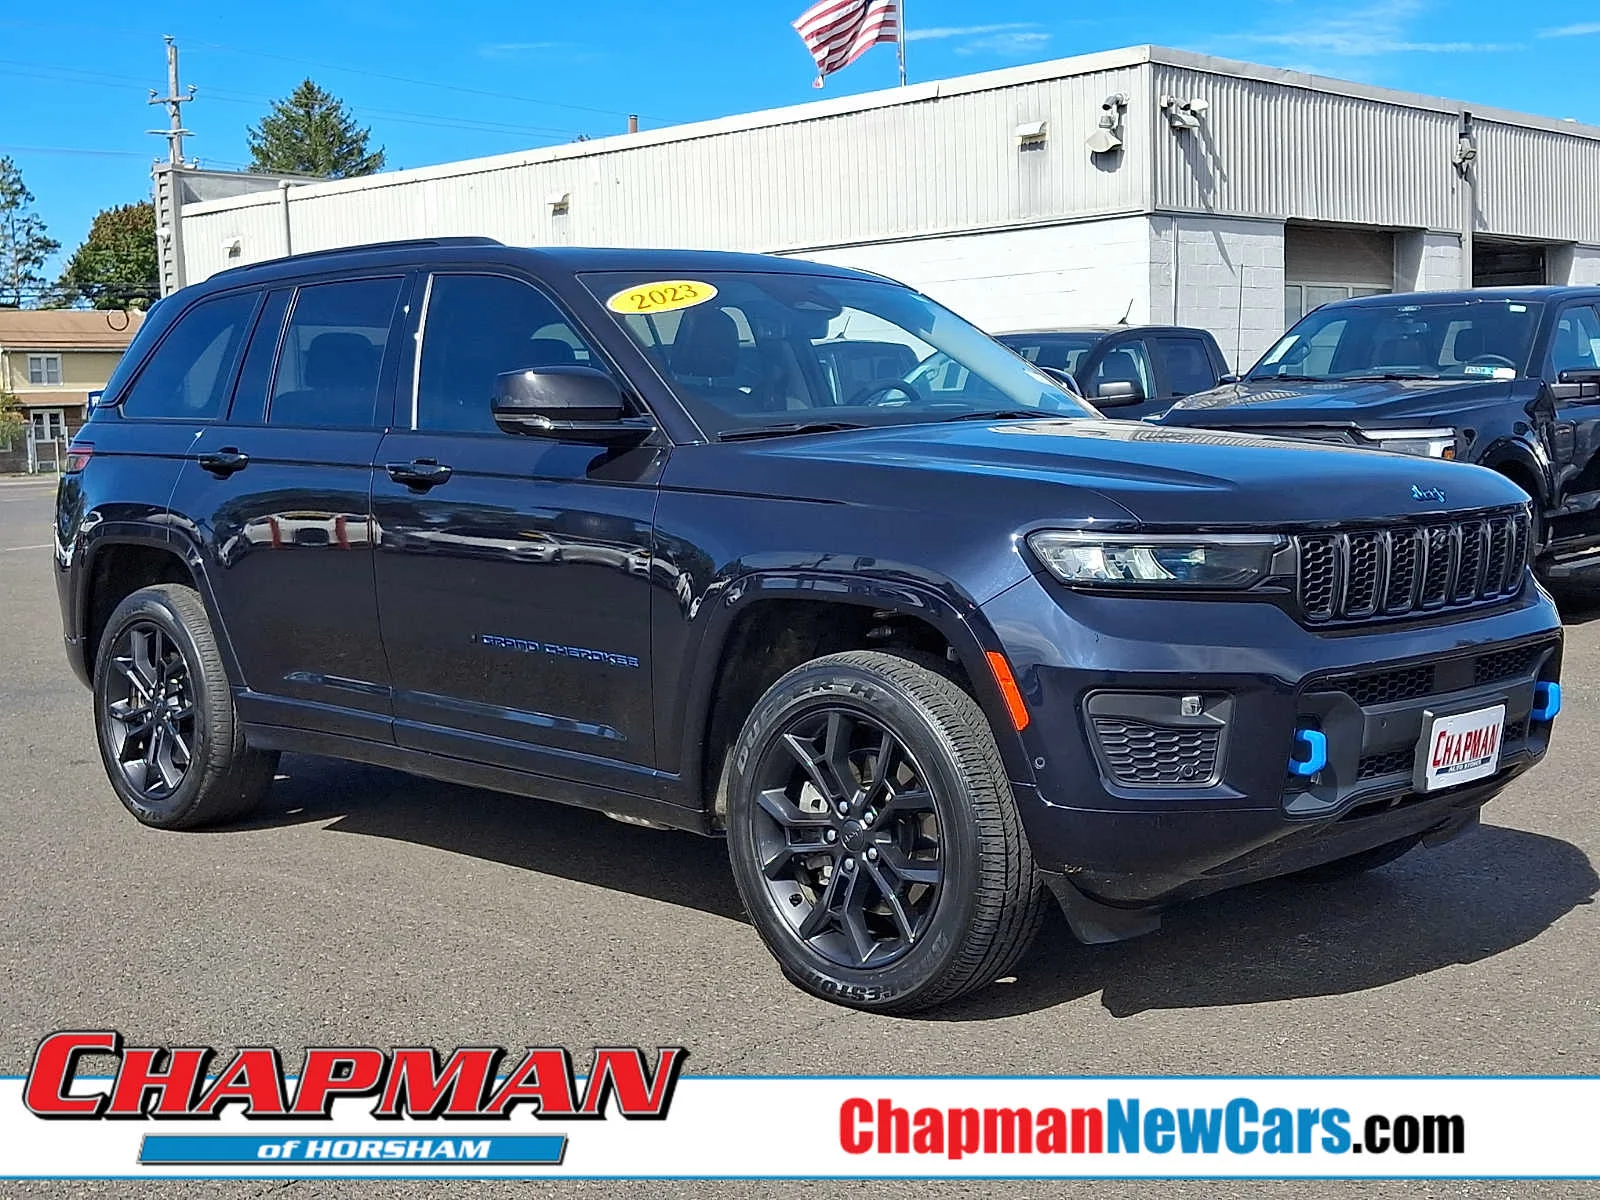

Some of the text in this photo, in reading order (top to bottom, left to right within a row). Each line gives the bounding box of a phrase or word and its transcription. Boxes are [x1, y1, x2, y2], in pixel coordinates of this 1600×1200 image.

[630, 284, 699, 310] 2023
[481, 634, 639, 668] GRAND CHEROKEE
[1432, 723, 1500, 768] CHAPMAN
